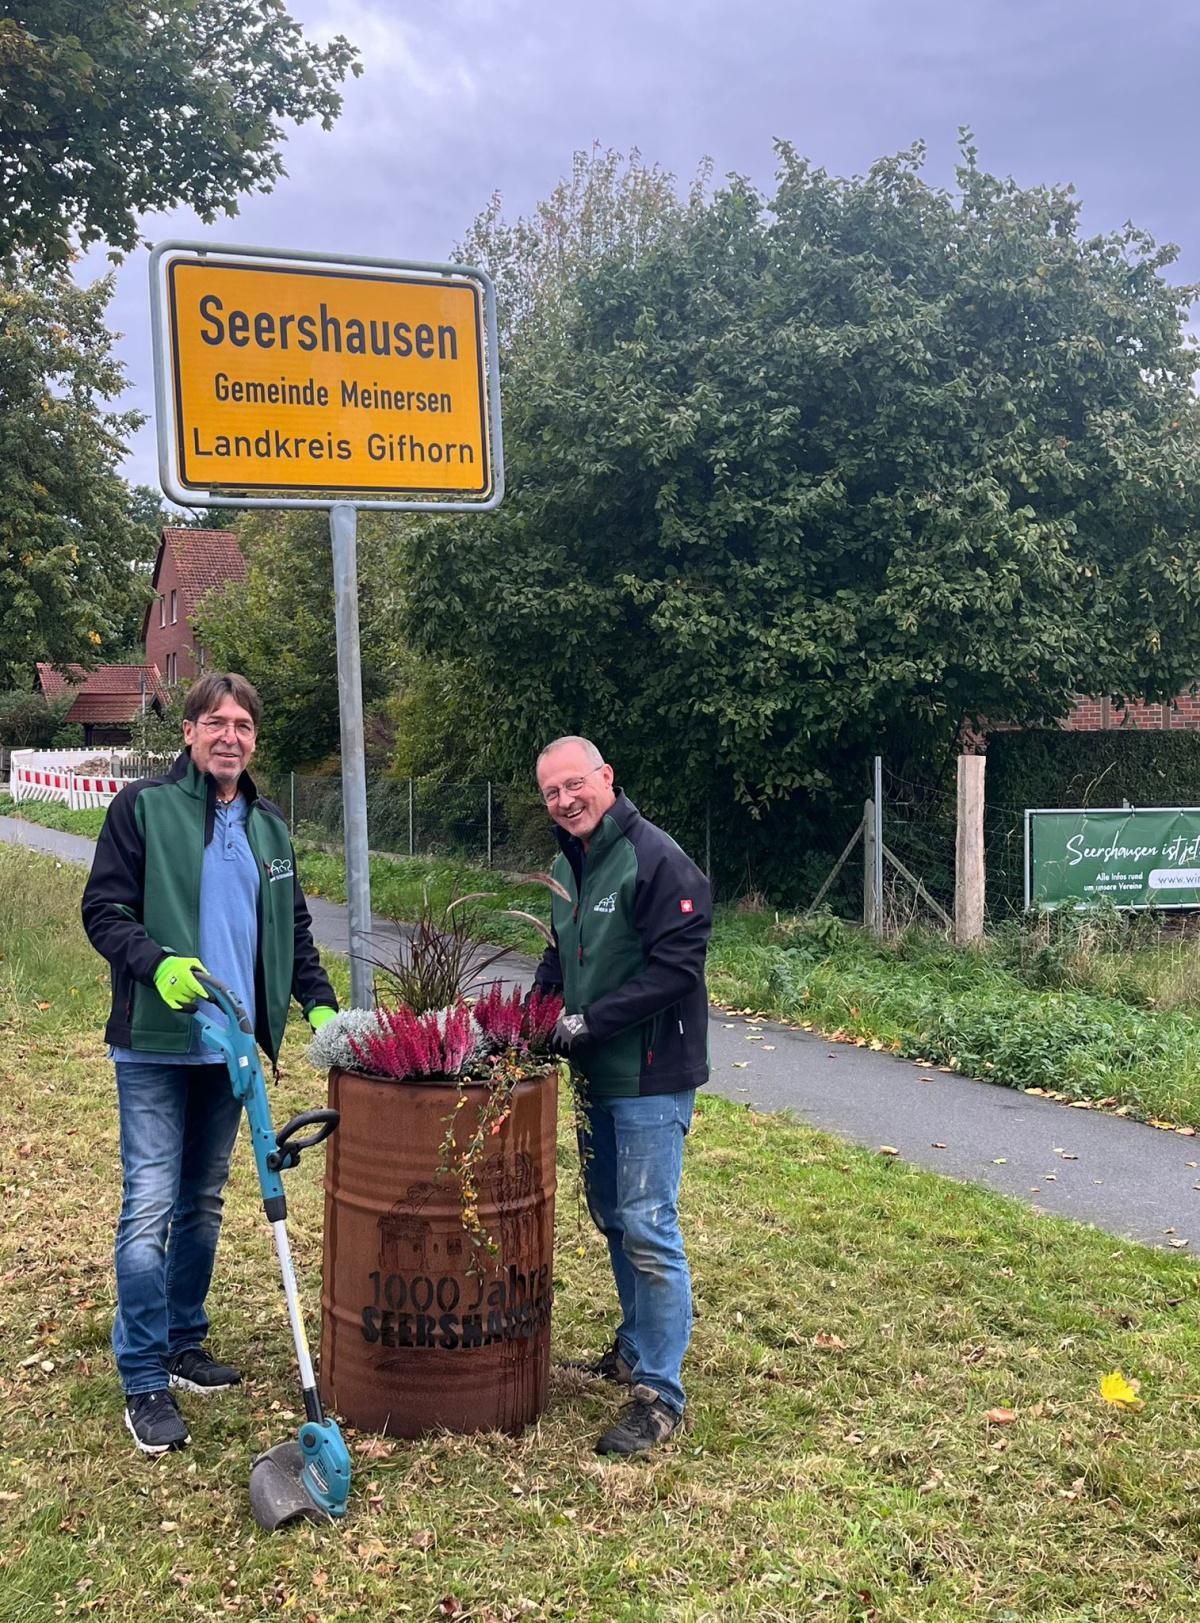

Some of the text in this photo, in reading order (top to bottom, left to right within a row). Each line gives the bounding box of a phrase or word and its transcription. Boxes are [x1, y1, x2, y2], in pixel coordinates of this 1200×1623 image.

[199, 294, 459, 361] Seershausen
[214, 372, 453, 413] Gemeinde Meinersen
[193, 427, 475, 464] Landkreis Gifhorn
[1065, 830, 1200, 866] Seershausen ist jet
[1095, 871, 1144, 881] Alle Infos rund
[1118, 881, 1143, 890] Vereine
[368, 1270, 461, 1313] 1000
[361, 1294, 552, 1350] SEERSHA
